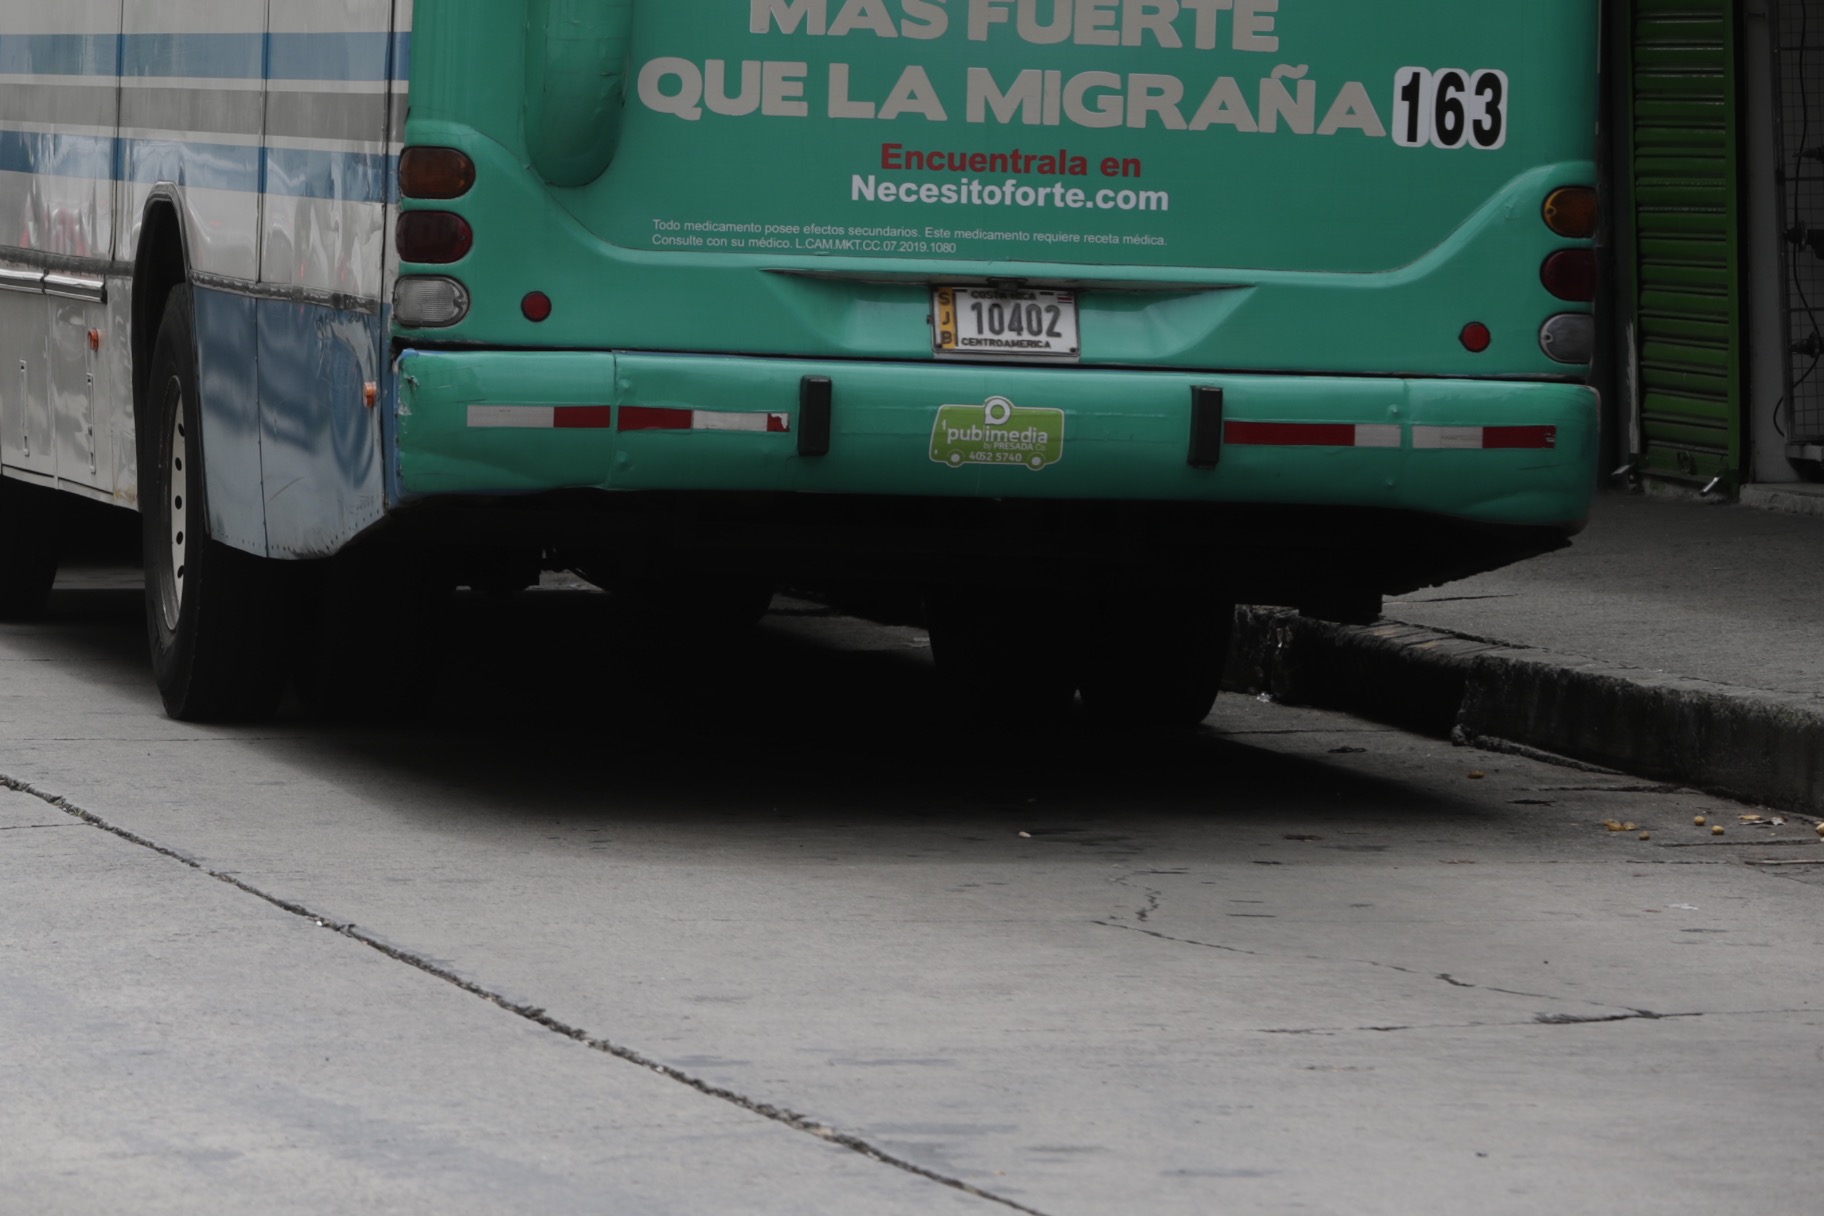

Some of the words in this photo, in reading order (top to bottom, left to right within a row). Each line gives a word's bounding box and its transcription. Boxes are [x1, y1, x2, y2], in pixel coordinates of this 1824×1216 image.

[637, 57, 809, 121] QUE
[828, 63, 948, 122] LA
[966, 64, 1387, 137] MIGRAÑA
[1400, 70, 1503, 148] 163
[881, 143, 1088, 176] Encuentrala
[1100, 156, 1142, 178] en
[851, 174, 1169, 211] Necesitoforte.com
[652, 234, 703, 246] Consulte
[706, 237, 727, 247] con
[731, 237, 745, 247] su
[748, 236, 793, 249] médico.
[796, 238, 957, 253] L.CAM.MKT.CC.07.2019.1080
[653, 219, 681, 231] Todo
[684, 220, 762, 233] medicamento
[764, 224, 800, 236] posee
[803, 222, 845, 235] efectos
[848, 225, 921, 238] secundarios.
[925, 227, 951, 238] Este
[954, 228, 1030, 241] medicamento
[1033, 231, 1081, 244] requiere
[1084, 234, 1120, 244] receta
[1122, 233, 1168, 246] médica.
[971, 302, 1062, 338] 10402
[961, 337, 1052, 349] CENTROAMERICA
[969, 451, 993, 461] 4052
[996, 452, 1023, 462] 5740
[983, 442, 992, 451] by
[993, 442, 1034, 451] PRESADA
